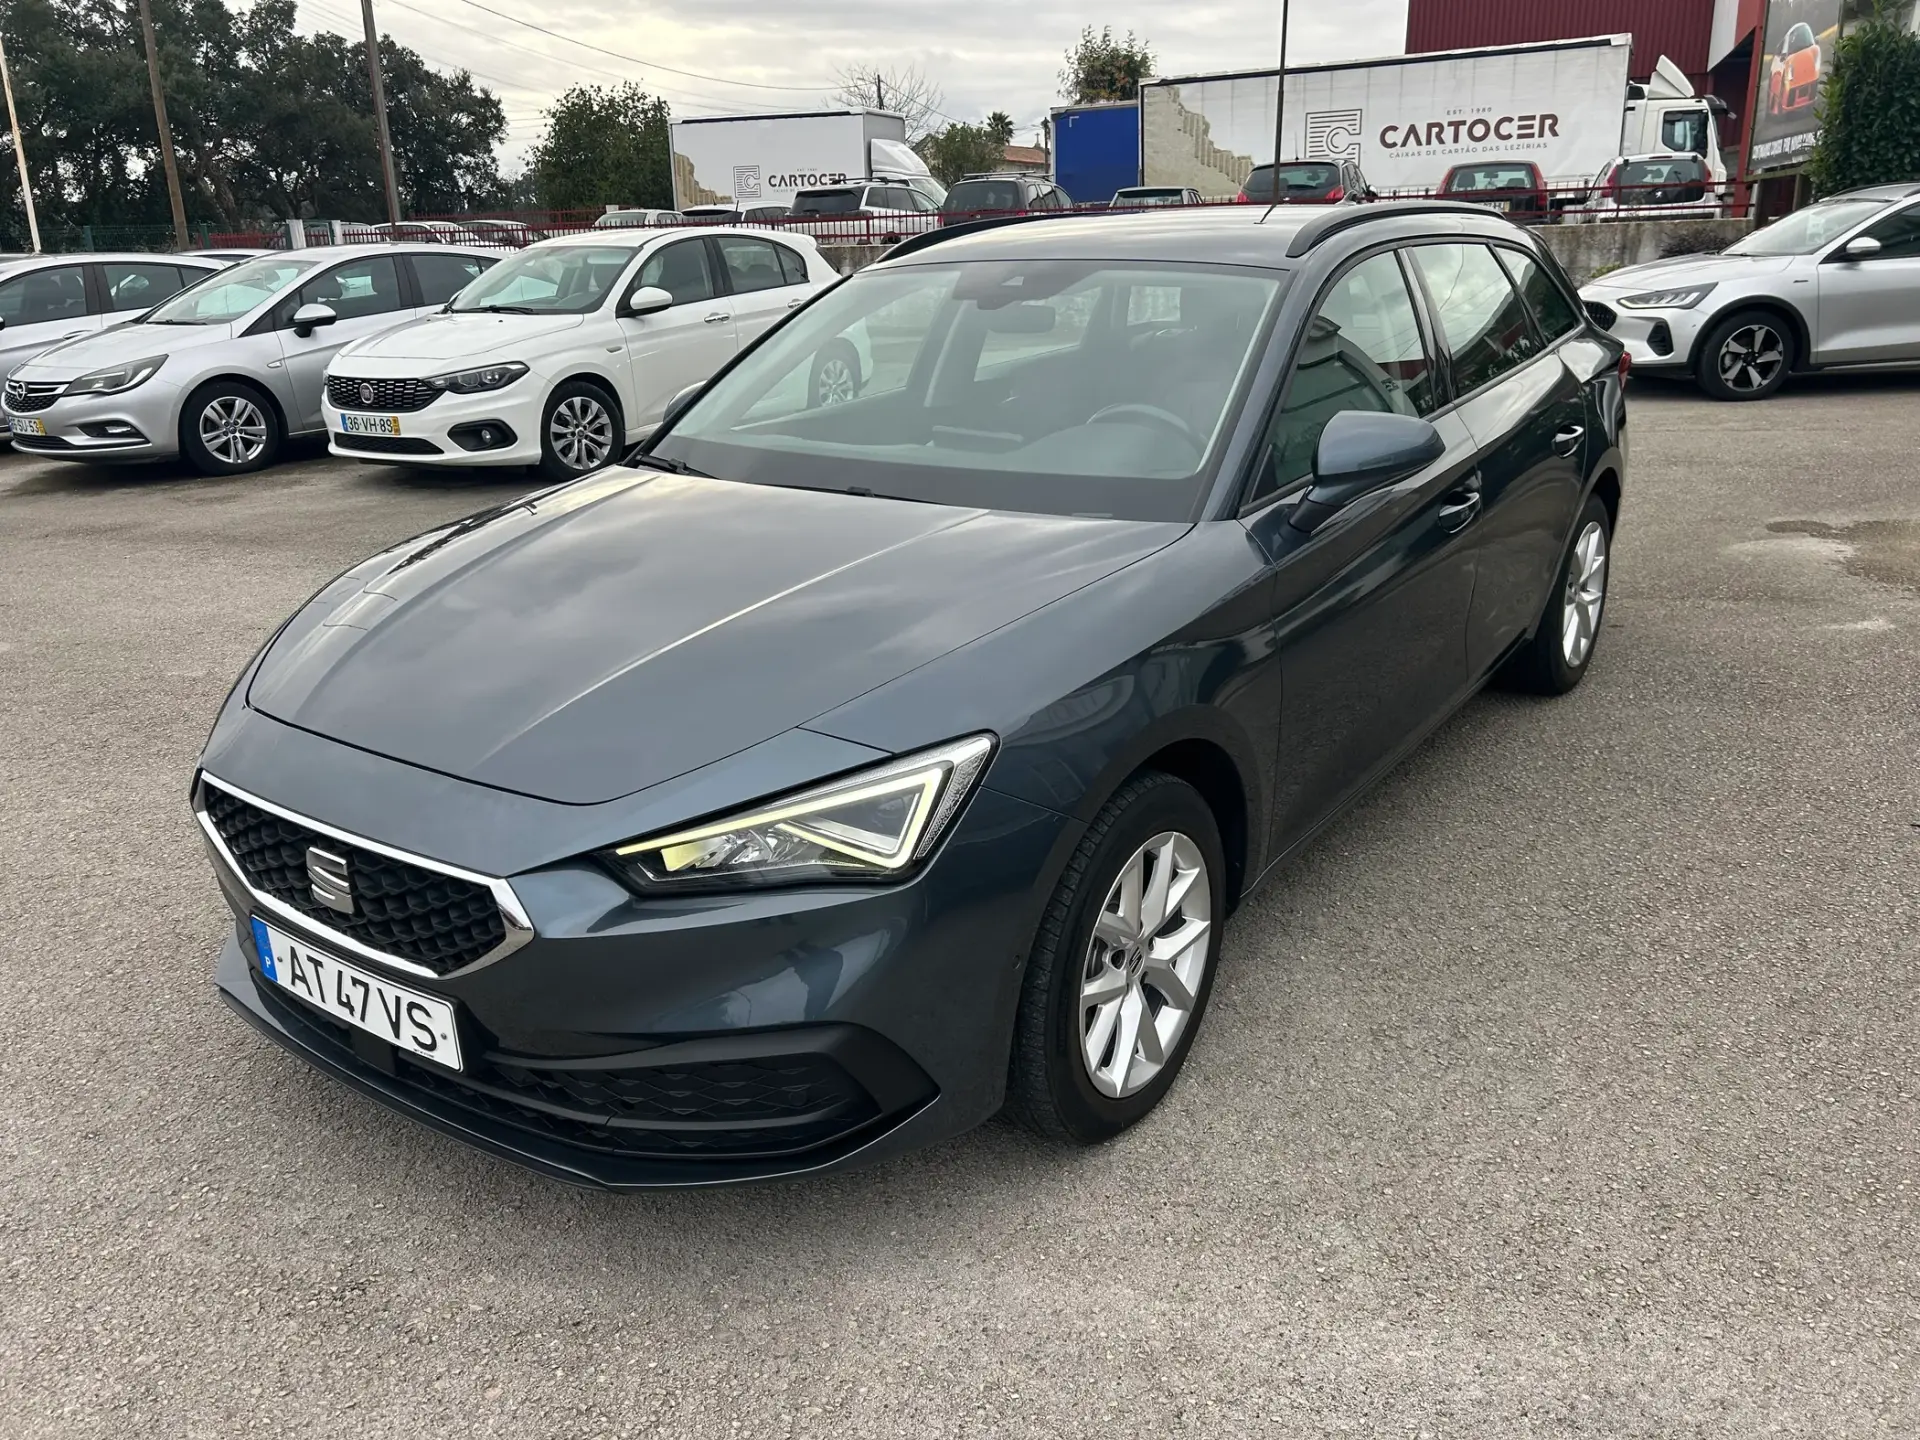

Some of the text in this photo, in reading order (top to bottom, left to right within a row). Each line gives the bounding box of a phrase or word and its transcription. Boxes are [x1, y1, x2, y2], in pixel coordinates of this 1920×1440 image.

[1379, 113, 1560, 149] CARTOCER
[1389, 151, 1422, 159] CAIXAS
[1441, 146, 1477, 155] CARTÃO
[1482, 145, 1501, 153] DAS
[1504, 142, 1548, 151] LEZÍRIAS
[768, 173, 847, 187] CARTOCER
[289, 945, 437, 1052] AT 47 VS
